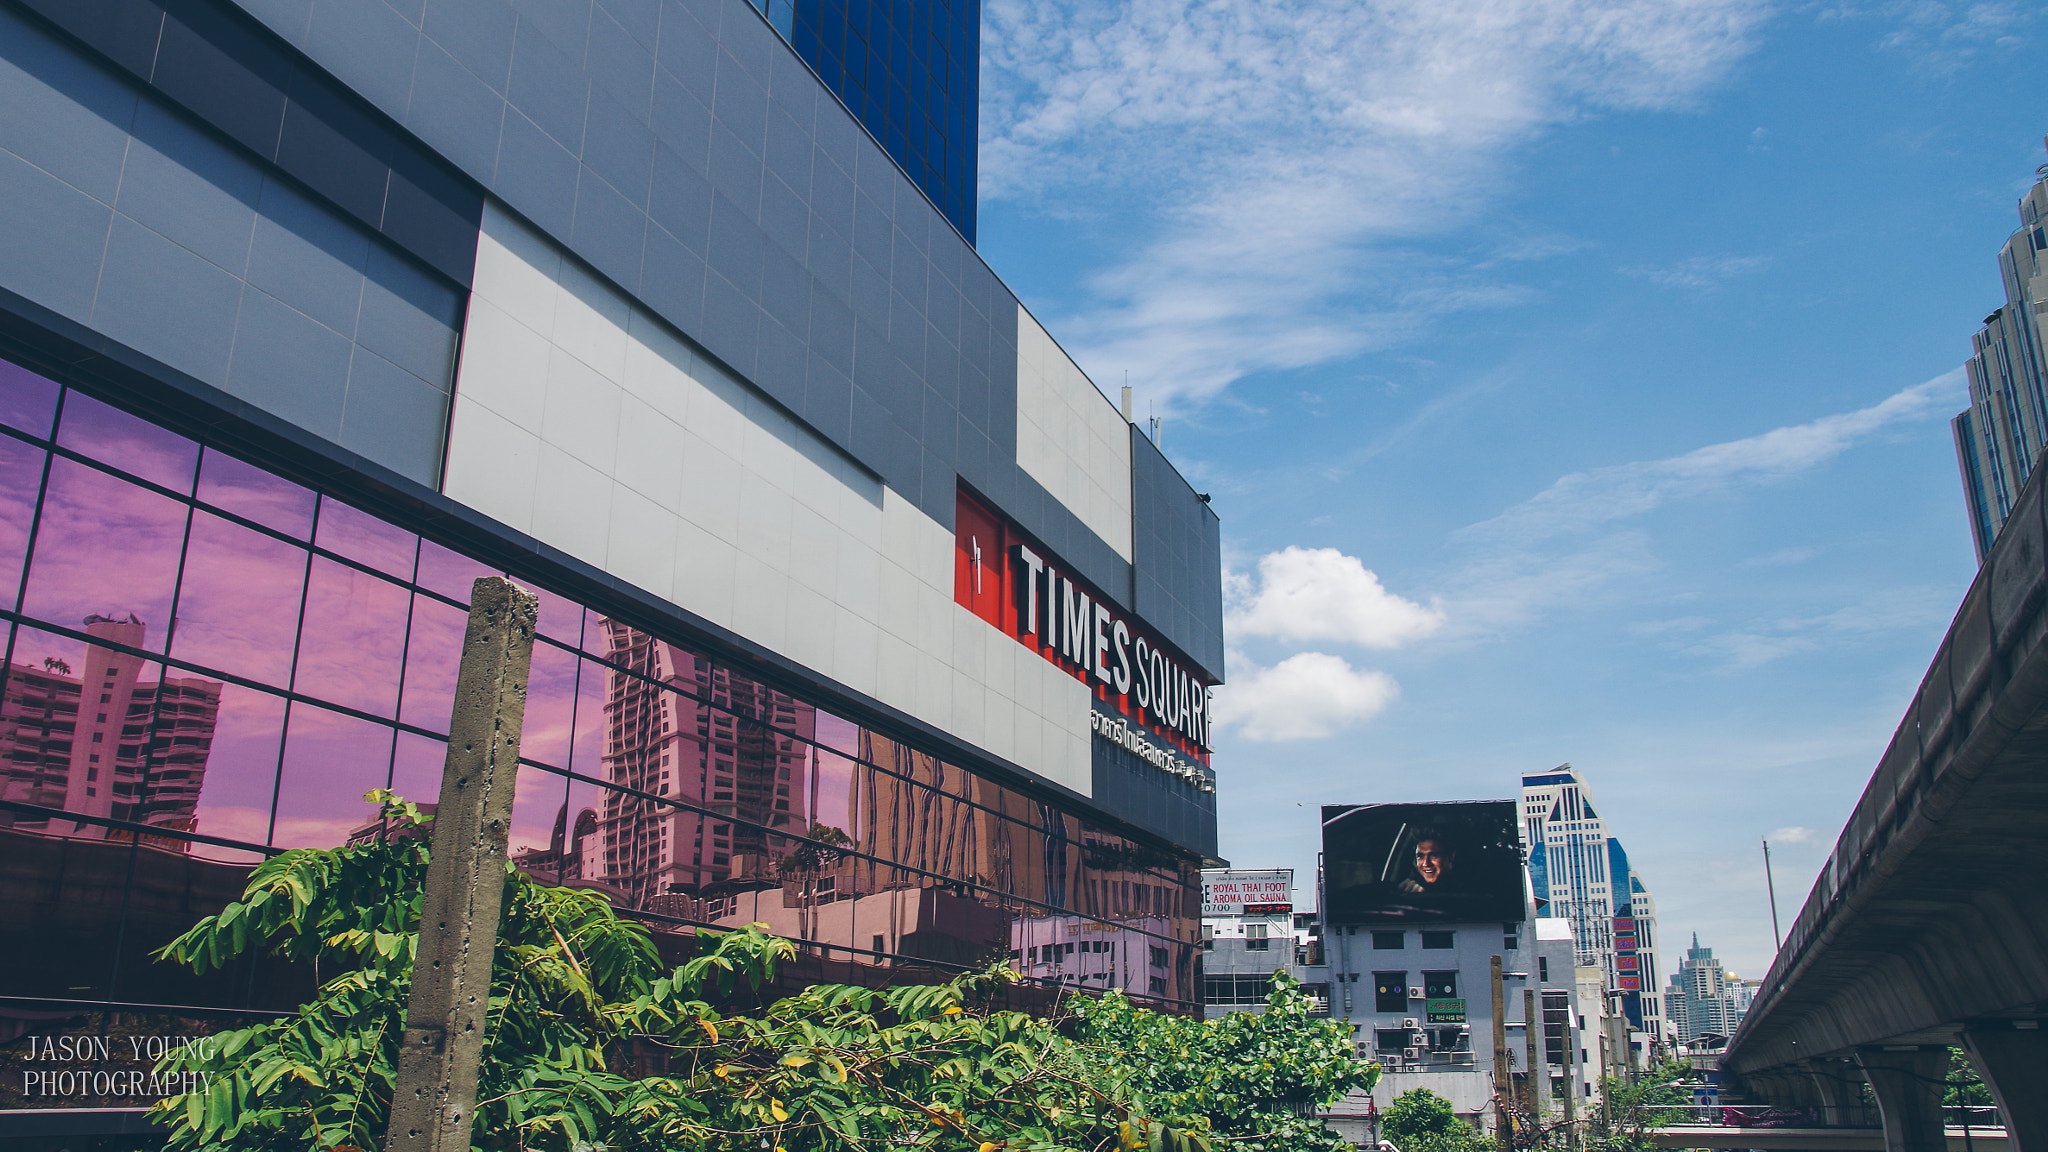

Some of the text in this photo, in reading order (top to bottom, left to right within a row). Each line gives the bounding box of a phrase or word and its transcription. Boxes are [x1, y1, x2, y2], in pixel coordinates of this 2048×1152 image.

[1021, 544, 1215, 753] TIMES SQUARE
[1213, 882, 1287, 893] ROYAL THAI FOOT
[1213, 894, 1287, 903] AROMA OIL SAUNA
